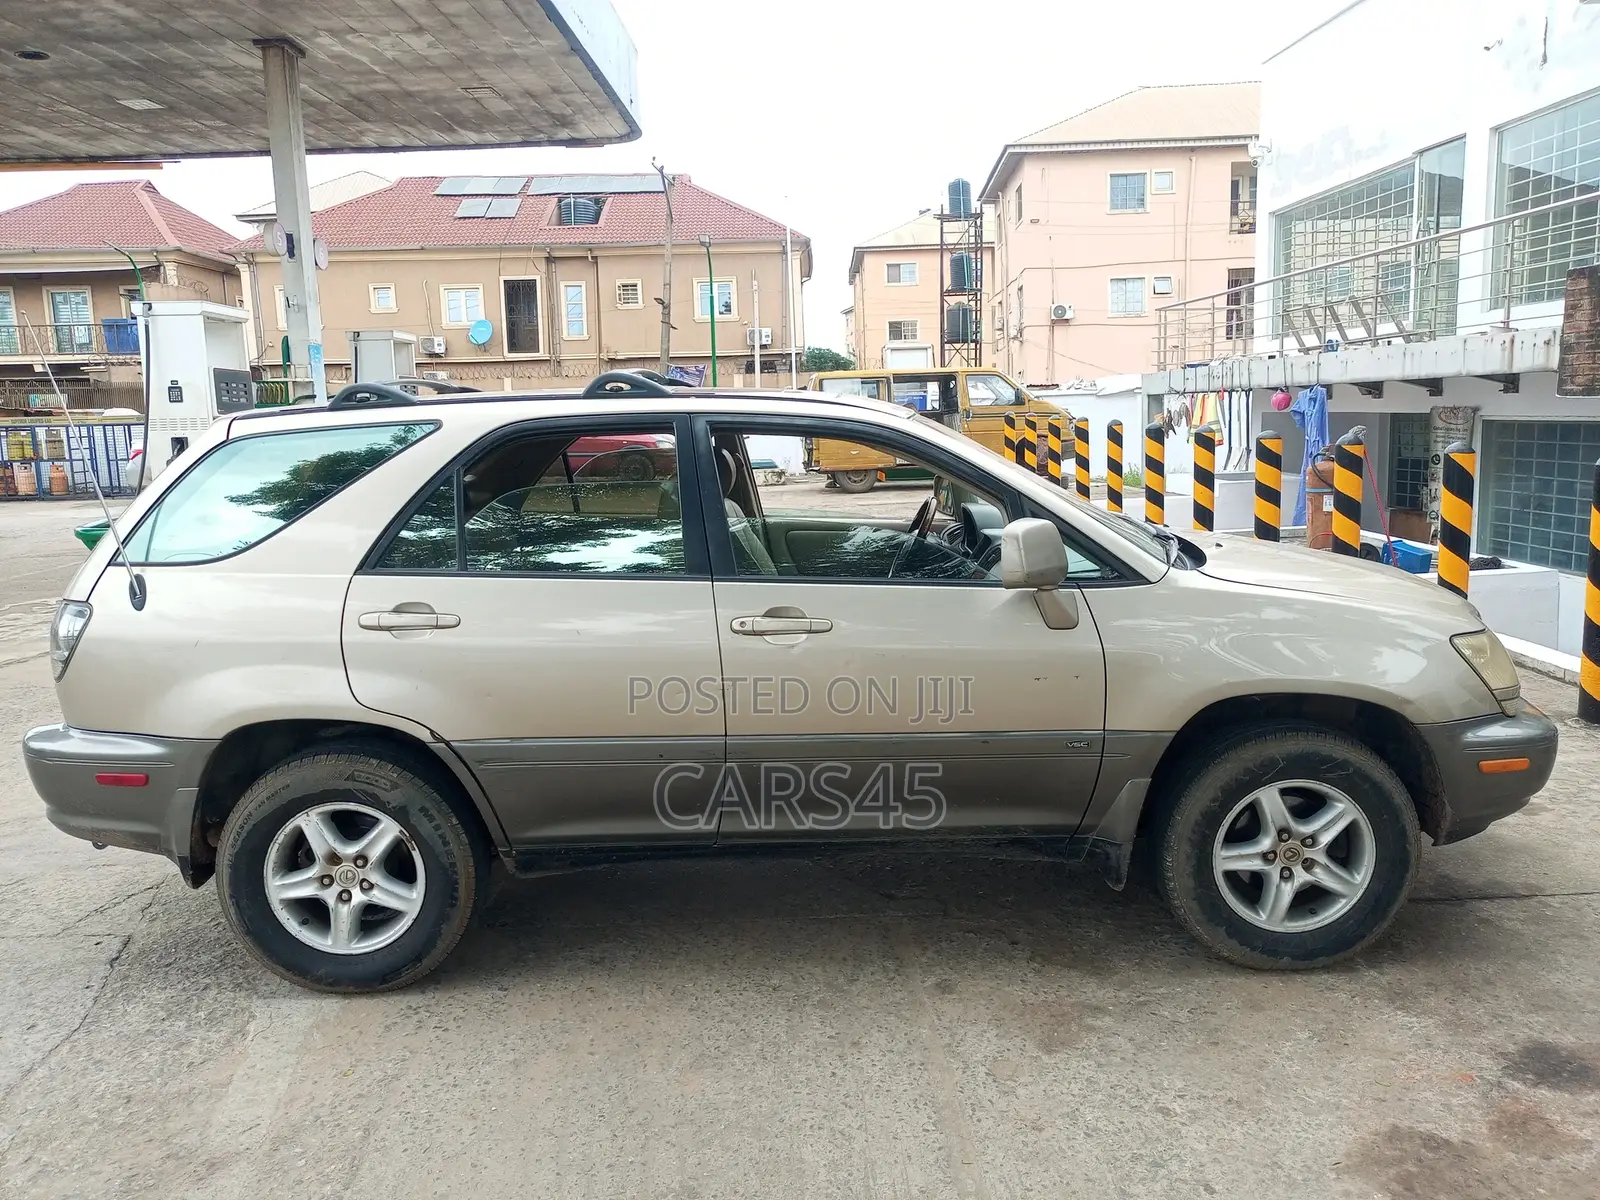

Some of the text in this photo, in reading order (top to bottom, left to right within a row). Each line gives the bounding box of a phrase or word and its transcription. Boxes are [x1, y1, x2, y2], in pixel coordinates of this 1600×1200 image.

[231, 810, 253, 850] SEASON
[254, 800, 266, 812] VAN
[265, 783, 291, 802] MASTER
